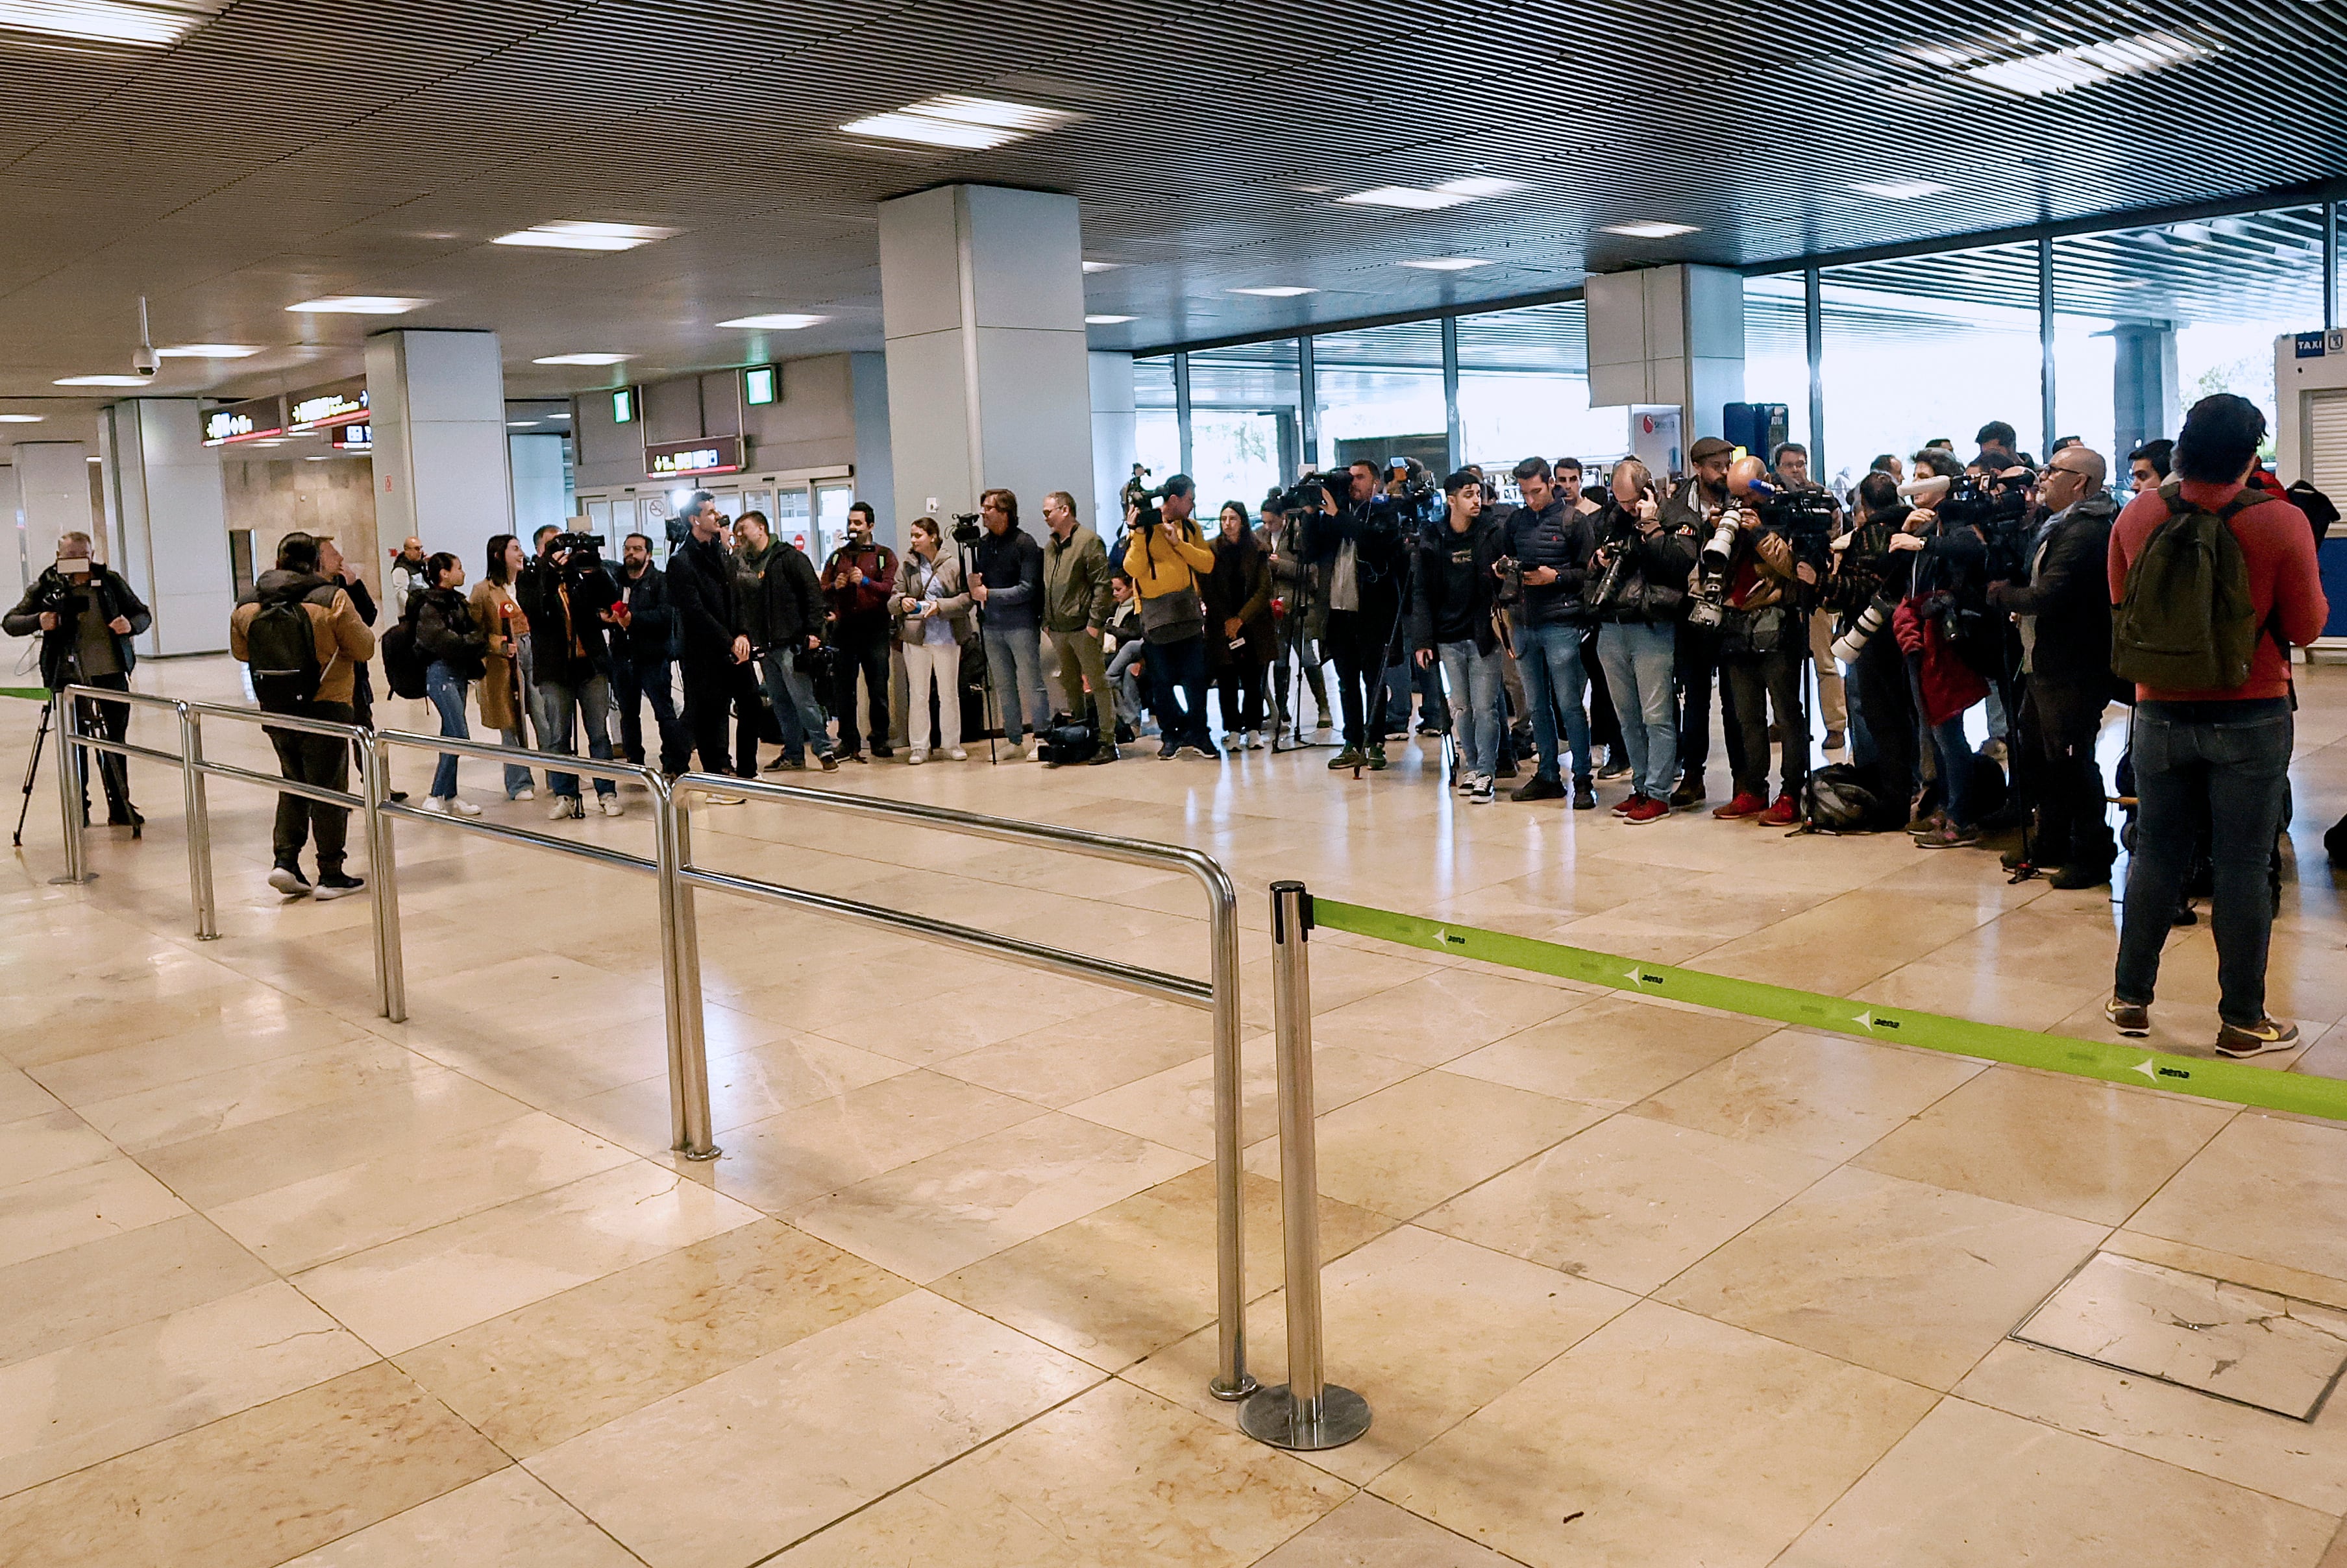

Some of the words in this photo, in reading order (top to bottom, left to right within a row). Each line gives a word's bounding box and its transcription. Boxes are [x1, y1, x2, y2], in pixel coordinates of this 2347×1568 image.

[2298, 340, 2322, 349] TAXI
[1874, 1018, 1899, 1029] aena
[2159, 1068, 2189, 1079] aena
